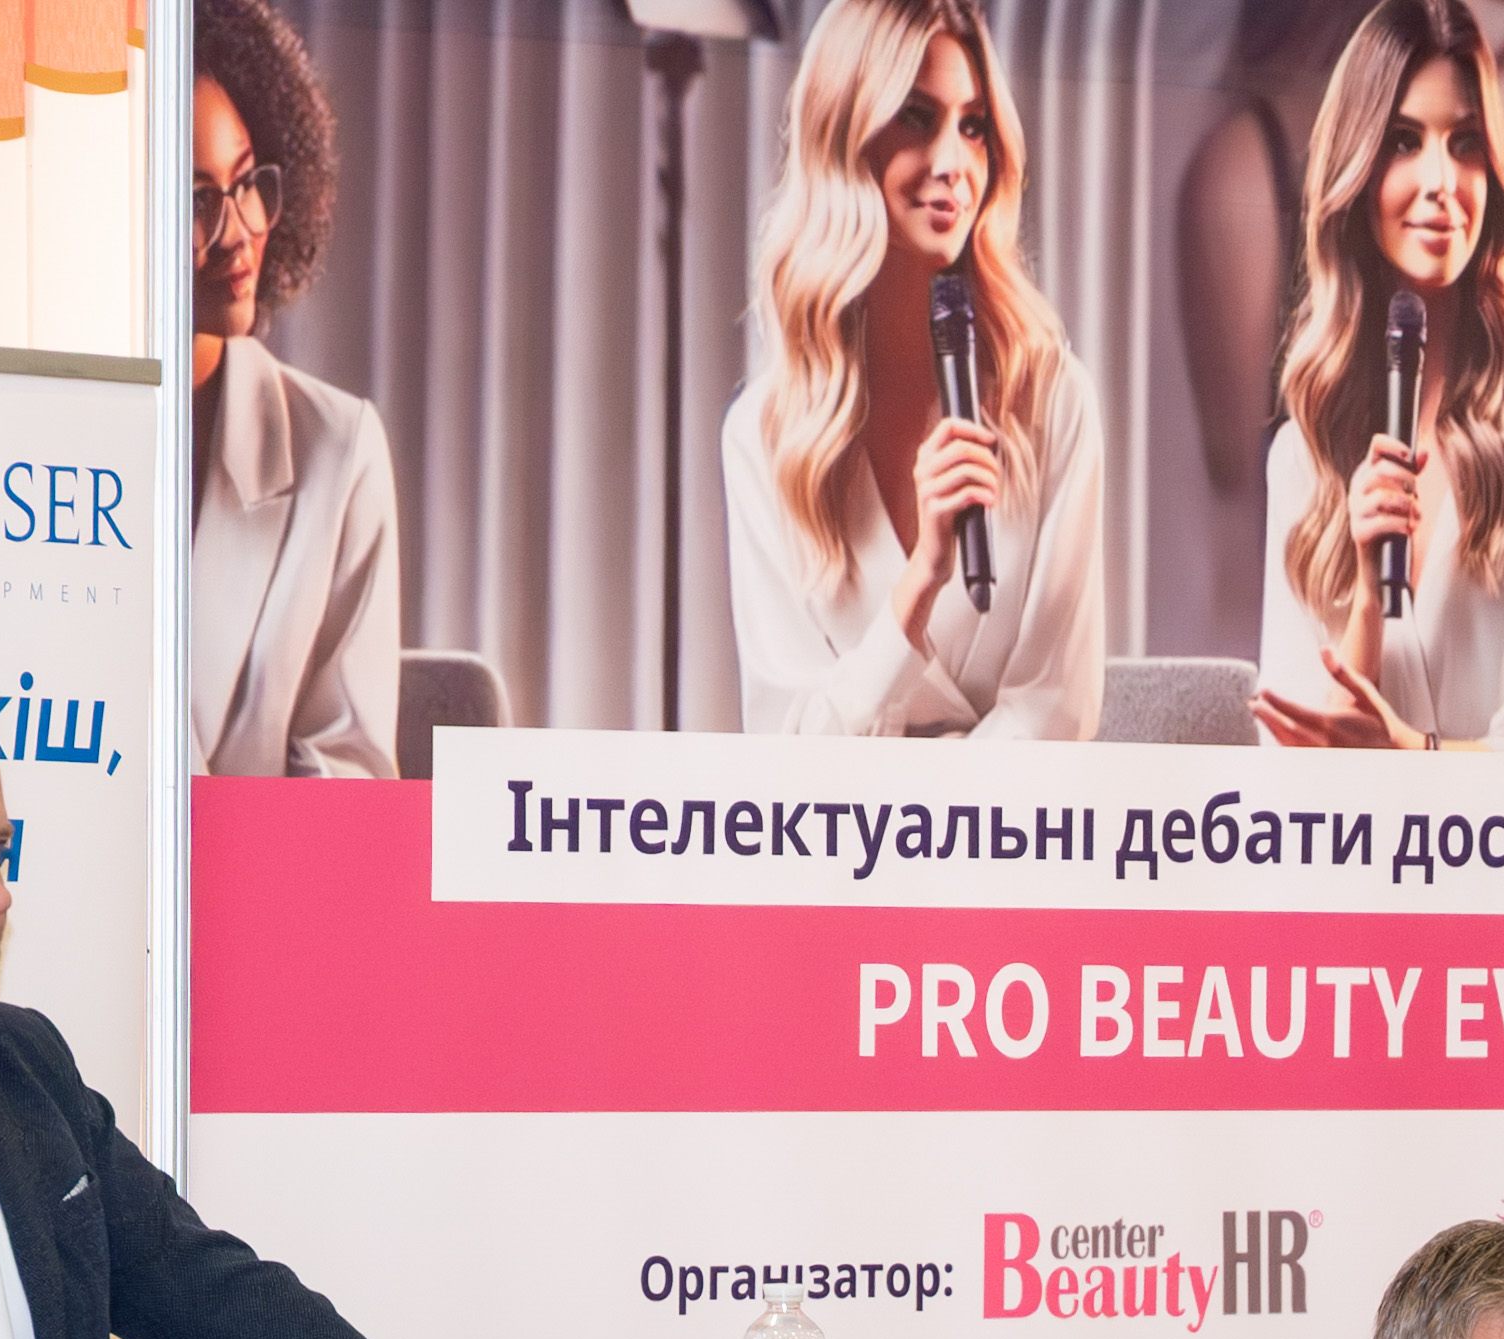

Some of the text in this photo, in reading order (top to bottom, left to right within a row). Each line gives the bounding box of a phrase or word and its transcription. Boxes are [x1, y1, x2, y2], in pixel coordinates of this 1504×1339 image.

[507, 780, 1095, 880] Інтелектуальні
[1116, 790, 1373, 880] дебати
[858, 962, 1050, 1059] PRO
[1078, 964, 1422, 1060] BEAUTY
[983, 1213, 1219, 1333] Beauty
[1050, 1218, 1164, 1260] center
